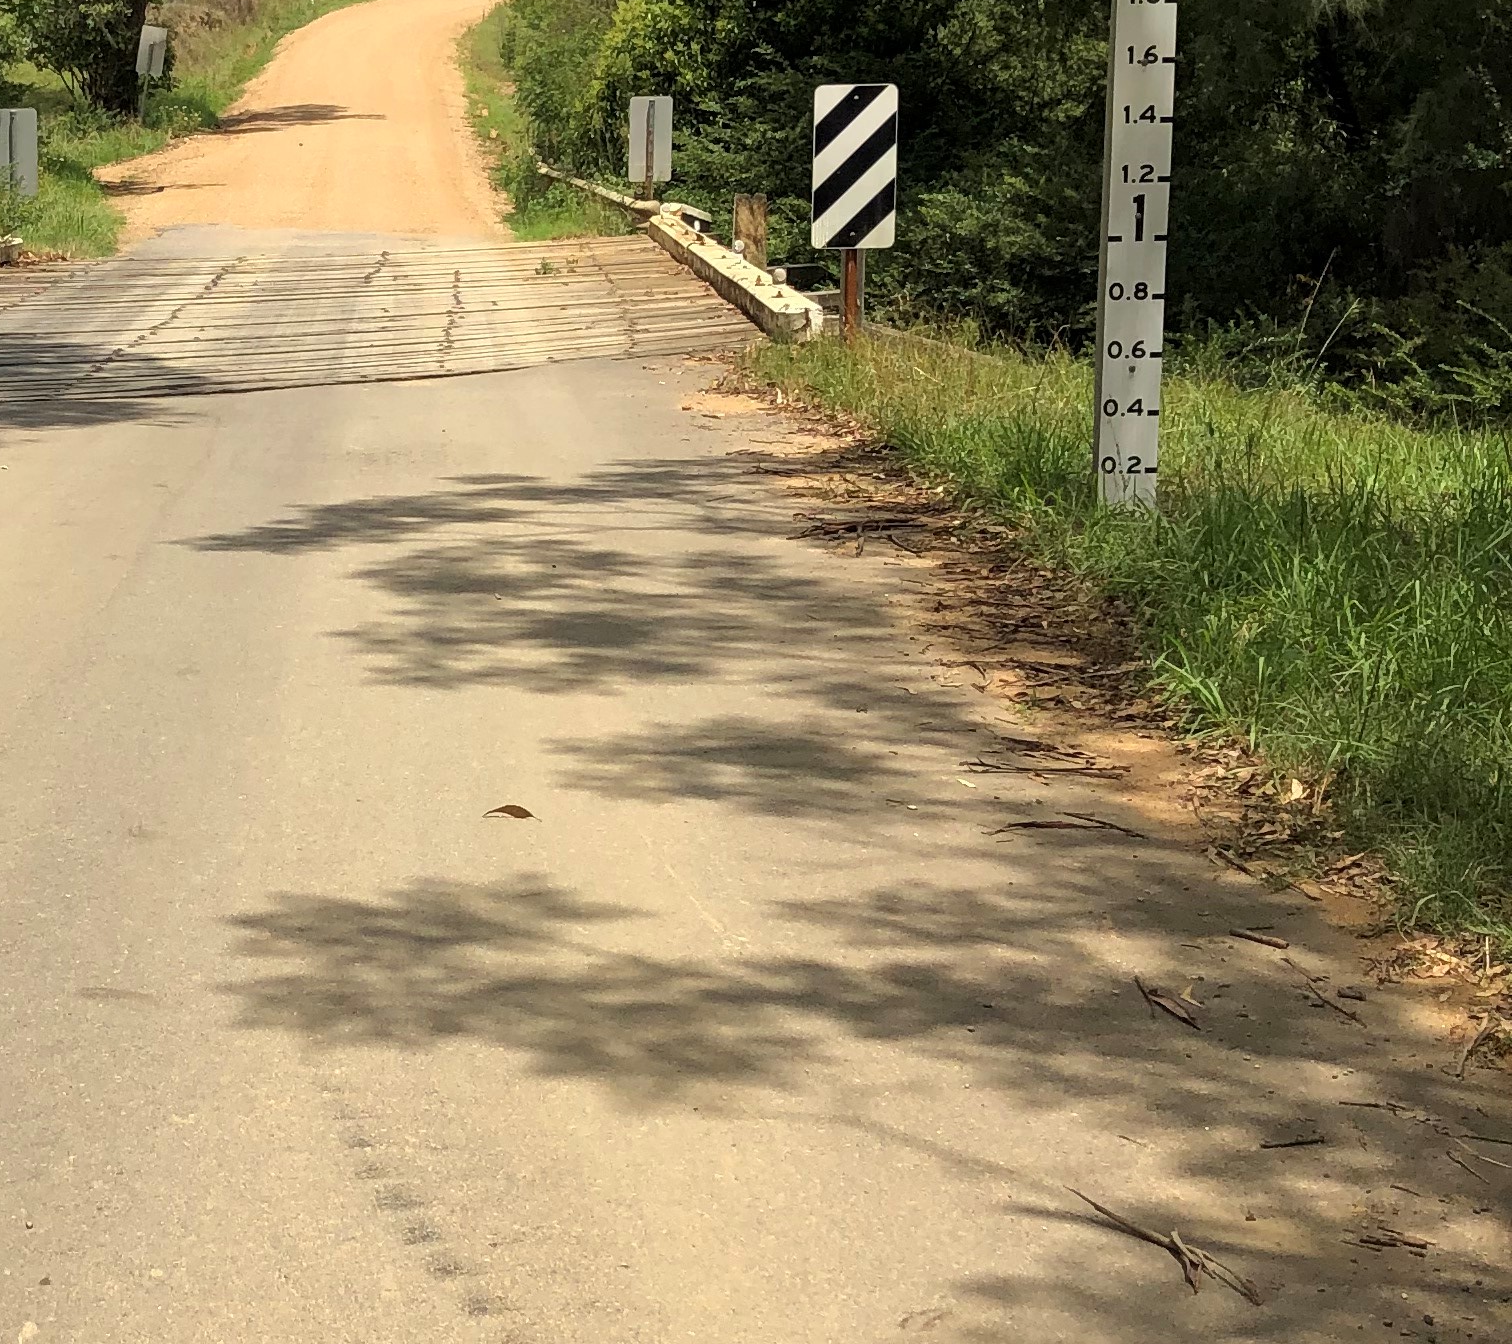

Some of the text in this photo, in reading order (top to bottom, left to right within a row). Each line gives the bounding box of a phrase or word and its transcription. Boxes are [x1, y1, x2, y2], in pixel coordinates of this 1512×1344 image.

[1127, 45, 1159, 65] 1.6
[1123, 105, 1157, 124] 1.4
[1121, 164, 1155, 184] 1.2
[1132, 193, 1146, 242] 1
[1108, 282, 1149, 301] 0.8
[1107, 340, 1146, 359] 0.6
[1102, 398, 1144, 417] 0.4
[1100, 456, 1142, 475] 0.2
